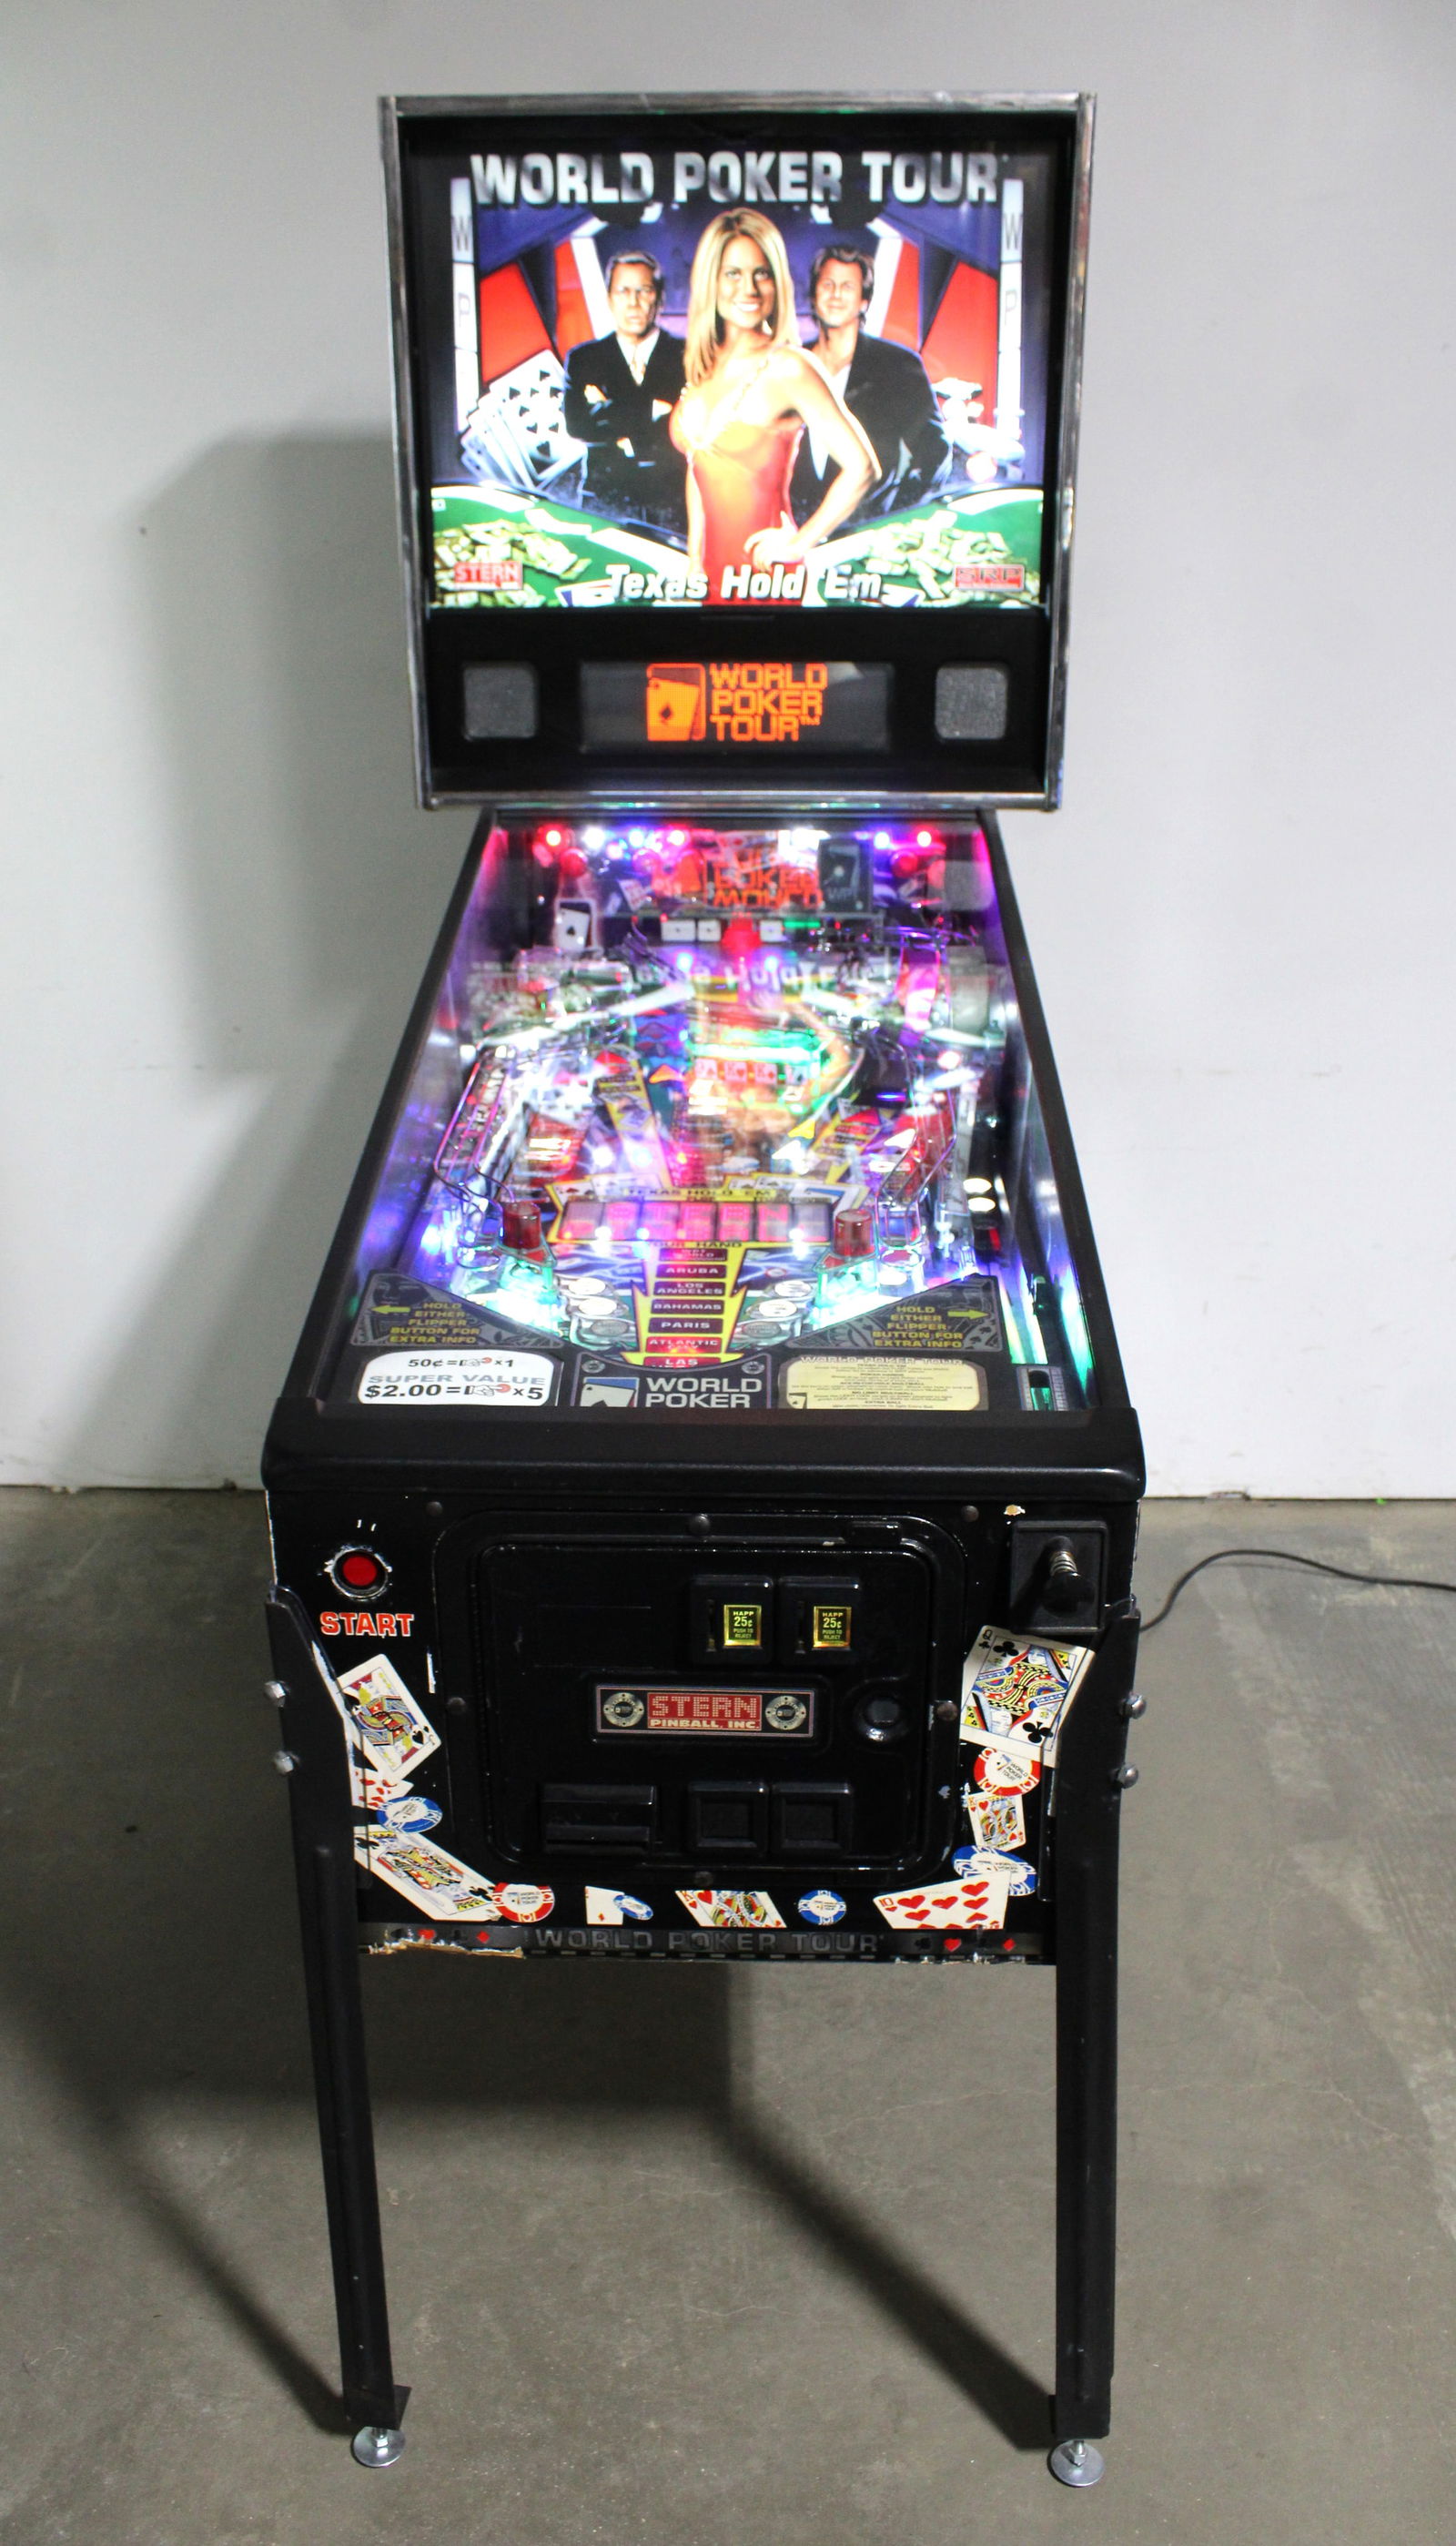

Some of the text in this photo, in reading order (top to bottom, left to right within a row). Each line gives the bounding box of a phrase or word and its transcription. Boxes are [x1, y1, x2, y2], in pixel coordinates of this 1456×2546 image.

[470, 151, 997, 204] WORLD POKER TOUR
[456, 565, 518, 583] STERN
[606, 564, 708, 600] Texas
[721, 564, 805, 599] Hold
[709, 663, 828, 689] WORLD
[711, 689, 823, 716] POKER
[422, 1303, 462, 1311] HOLD
[895, 1305, 936, 1314] HOLD
[414, 1310, 466, 1318] EITHER
[890, 1314, 943, 1322] EITHER
[409, 1318, 468, 1326] FLIPPER
[886, 1322, 948, 1330] FLIPPER
[389, 1327, 480, 1335] BUTTON FOR
[871, 1331, 964, 1340] BUTTON FOR
[389, 1335, 478, 1344] EXTRA INFO
[874, 1339, 964, 1349] EXTRA INFO
[665, 1358, 699, 1366] LAS
[800, 1355, 857, 1364] WORLD
[864, 1356, 915, 1365] POKER
[368, 1374, 547, 1385] SUPER VALUE
[644, 1377, 763, 1393] WORLD
[644, 1393, 751, 1408] POKER
[319, 1610, 415, 1638] START
[652, 1696, 757, 1719] STERN
[727, 1720, 761, 1729] INC.
[534, 1928, 877, 1953] WORLD POKER TOUR
